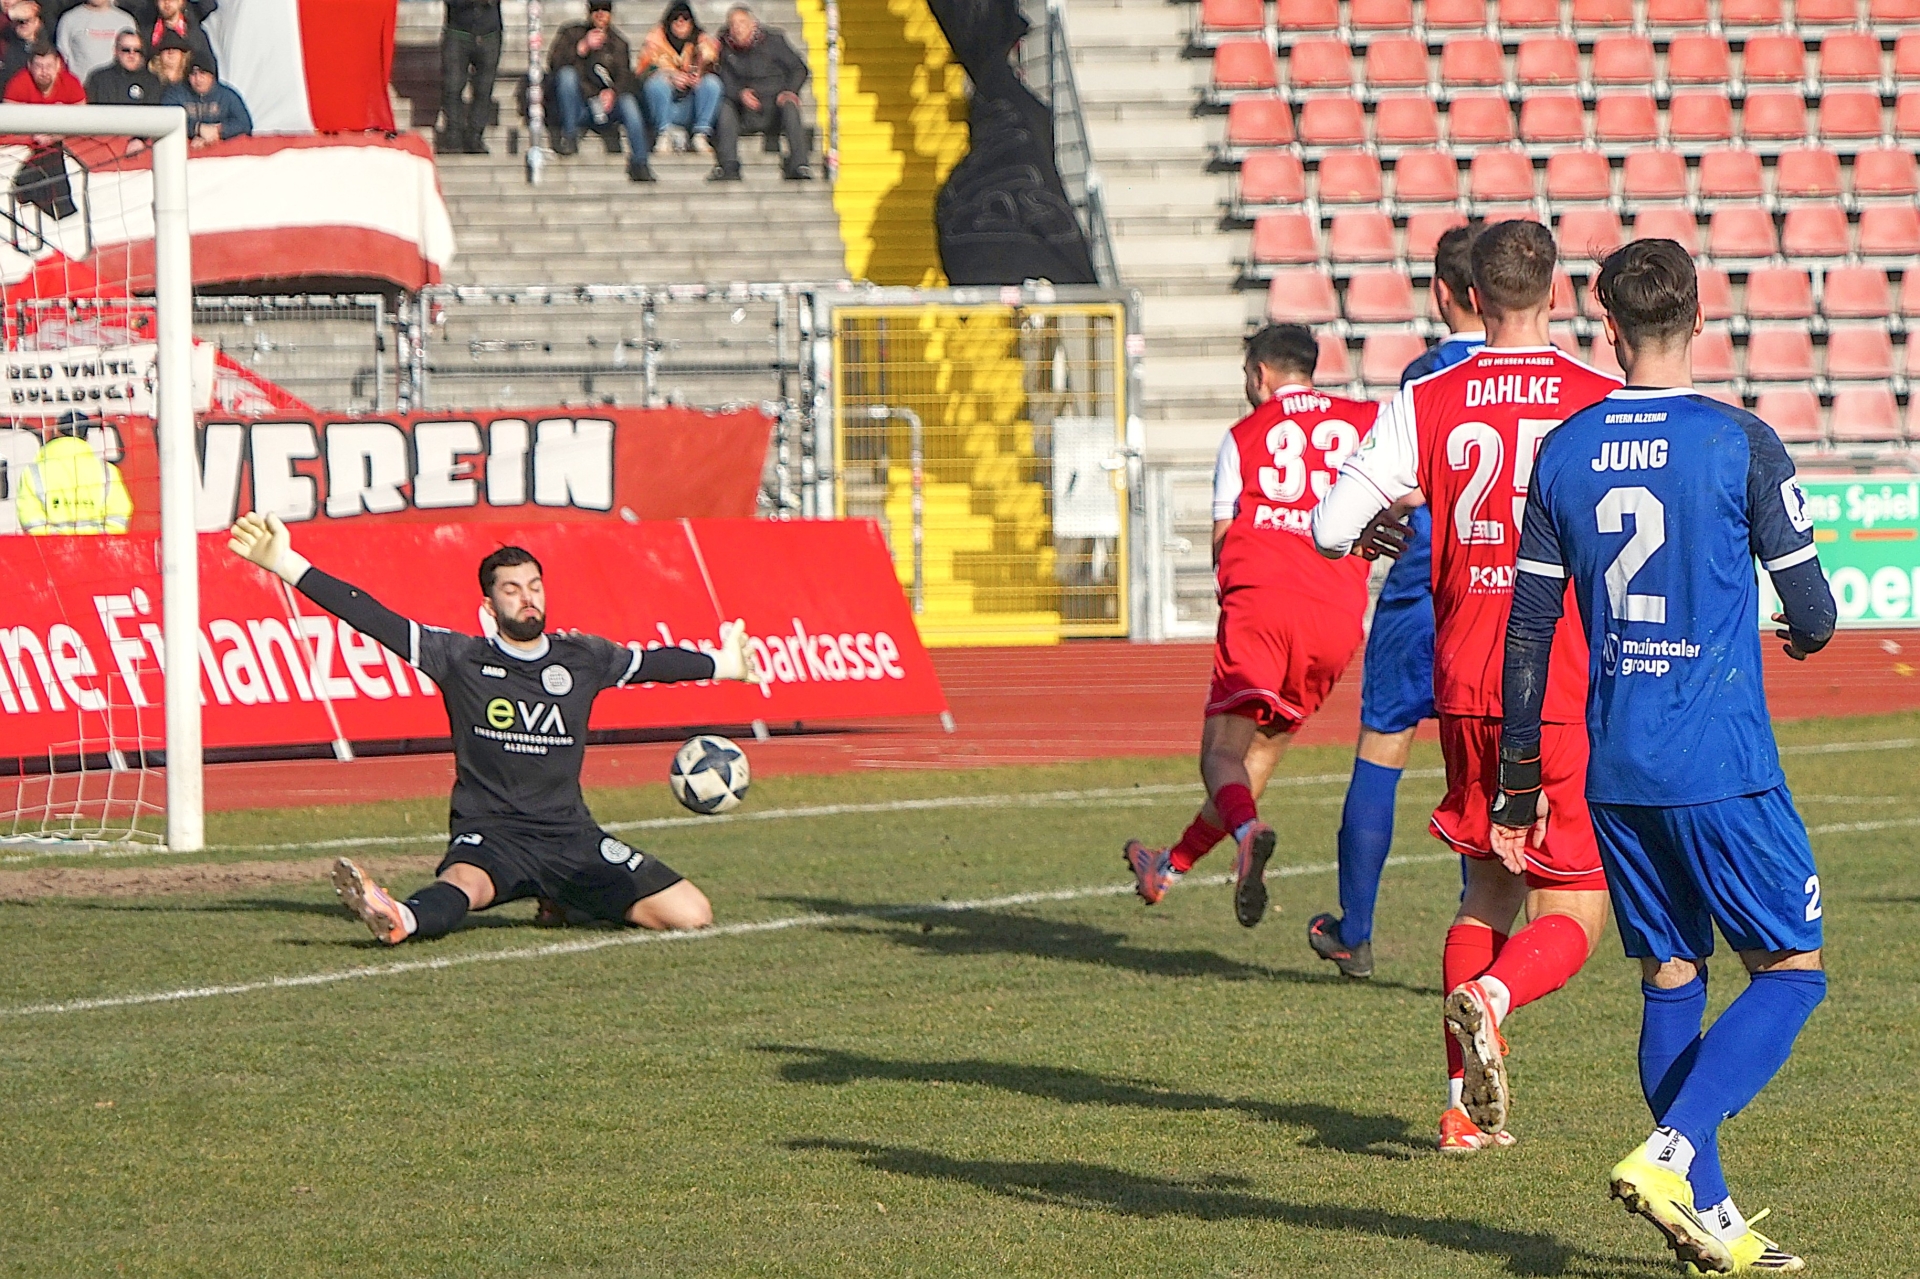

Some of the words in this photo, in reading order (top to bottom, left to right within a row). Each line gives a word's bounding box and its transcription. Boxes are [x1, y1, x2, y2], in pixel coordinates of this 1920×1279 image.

[7, 363, 53, 379] RED
[1493, 357, 1525, 366] HESSEN
[1525, 356, 1555, 366] KASSEL
[1465, 374, 1562, 407] DAHLKE
[1282, 394, 1332, 416] RUPP
[1605, 413, 1634, 424] BAYERN
[1634, 412, 1668, 423] ALZENAU
[1258, 419, 1360, 503] 33
[1591, 438, 1669, 472] JUNG
[160, 418, 615, 533] VEREIN
[1845, 482, 1919, 529] Spiel
[1595, 486, 1666, 624] 2
[1622, 637, 1701, 658] maintaler
[1621, 658, 1671, 678] group
[474, 726, 575, 746] ENERGIEVERSORGUNG
[503, 742, 548, 755] ALZENAU
[1804, 874, 1823, 922] 2
